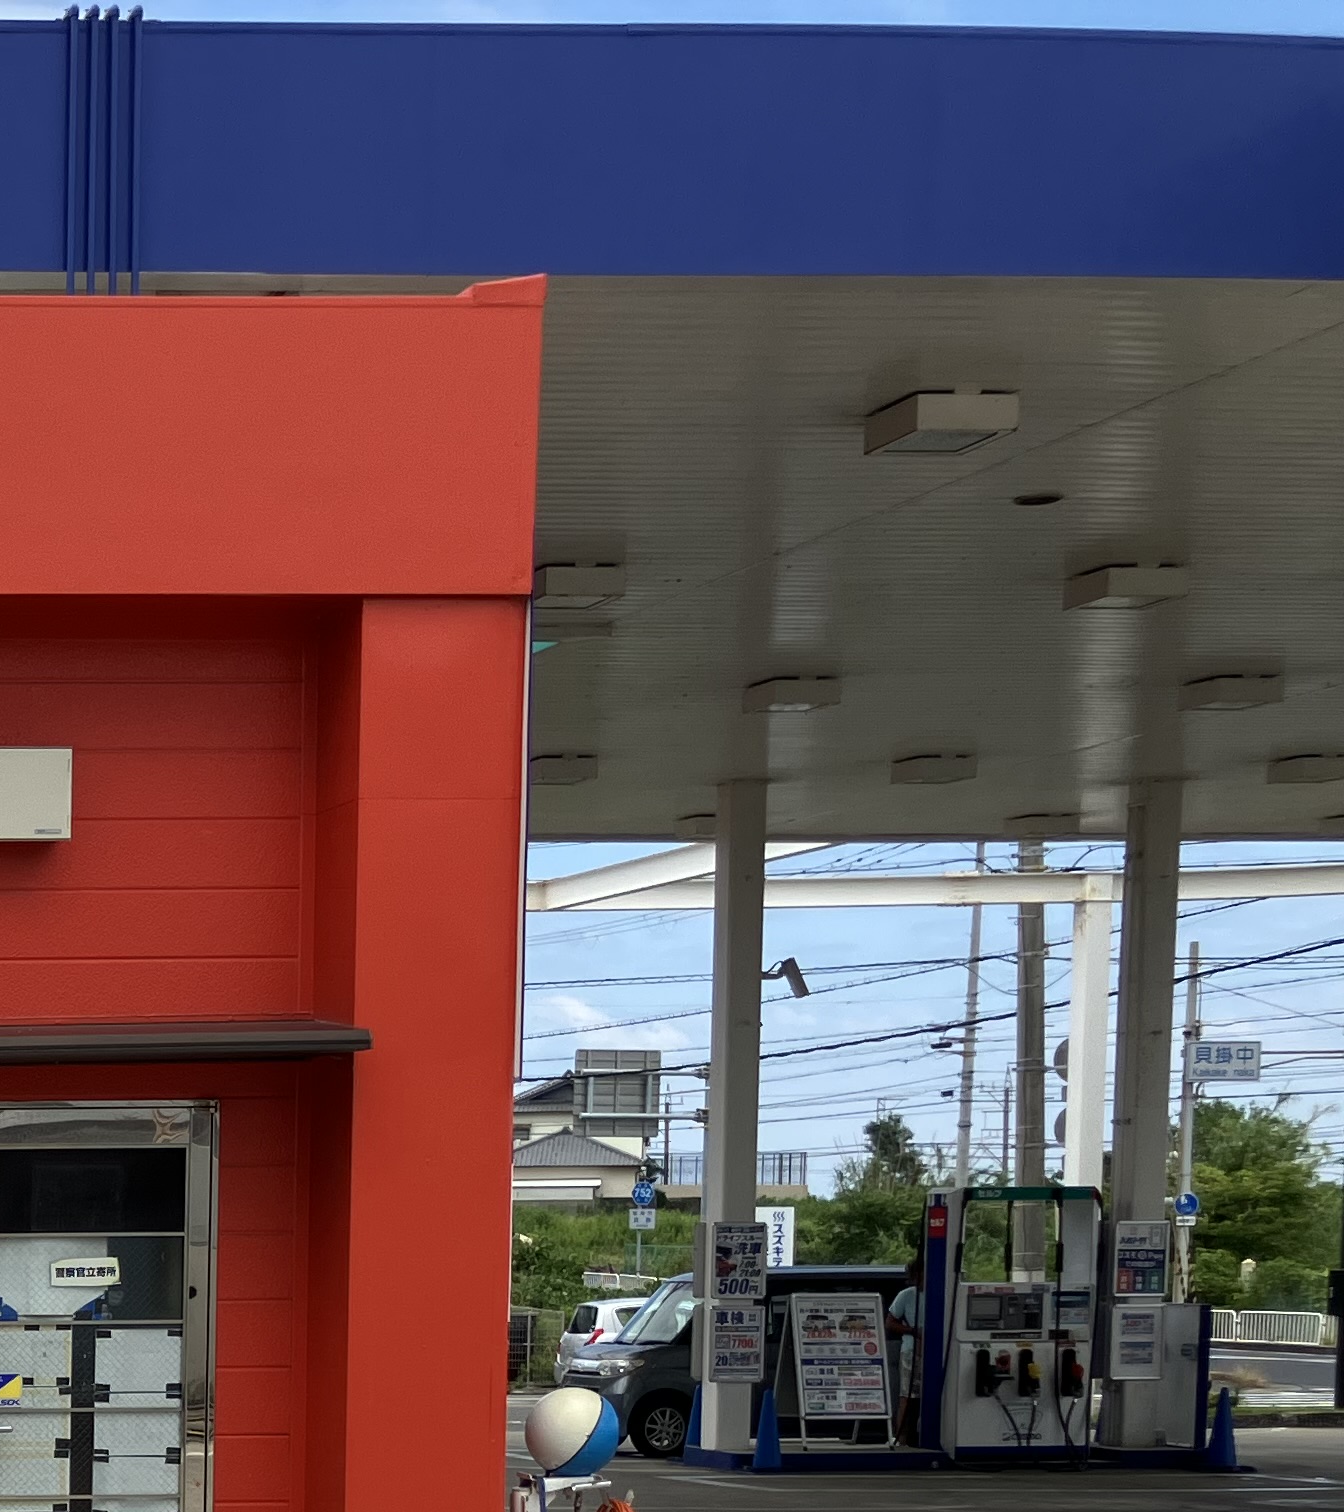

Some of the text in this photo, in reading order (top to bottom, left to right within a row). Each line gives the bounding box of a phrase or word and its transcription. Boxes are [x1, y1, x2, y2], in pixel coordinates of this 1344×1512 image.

[1194, 1046, 1254, 1066] 貝掛中
[634, 1188, 652, 1197] 752
